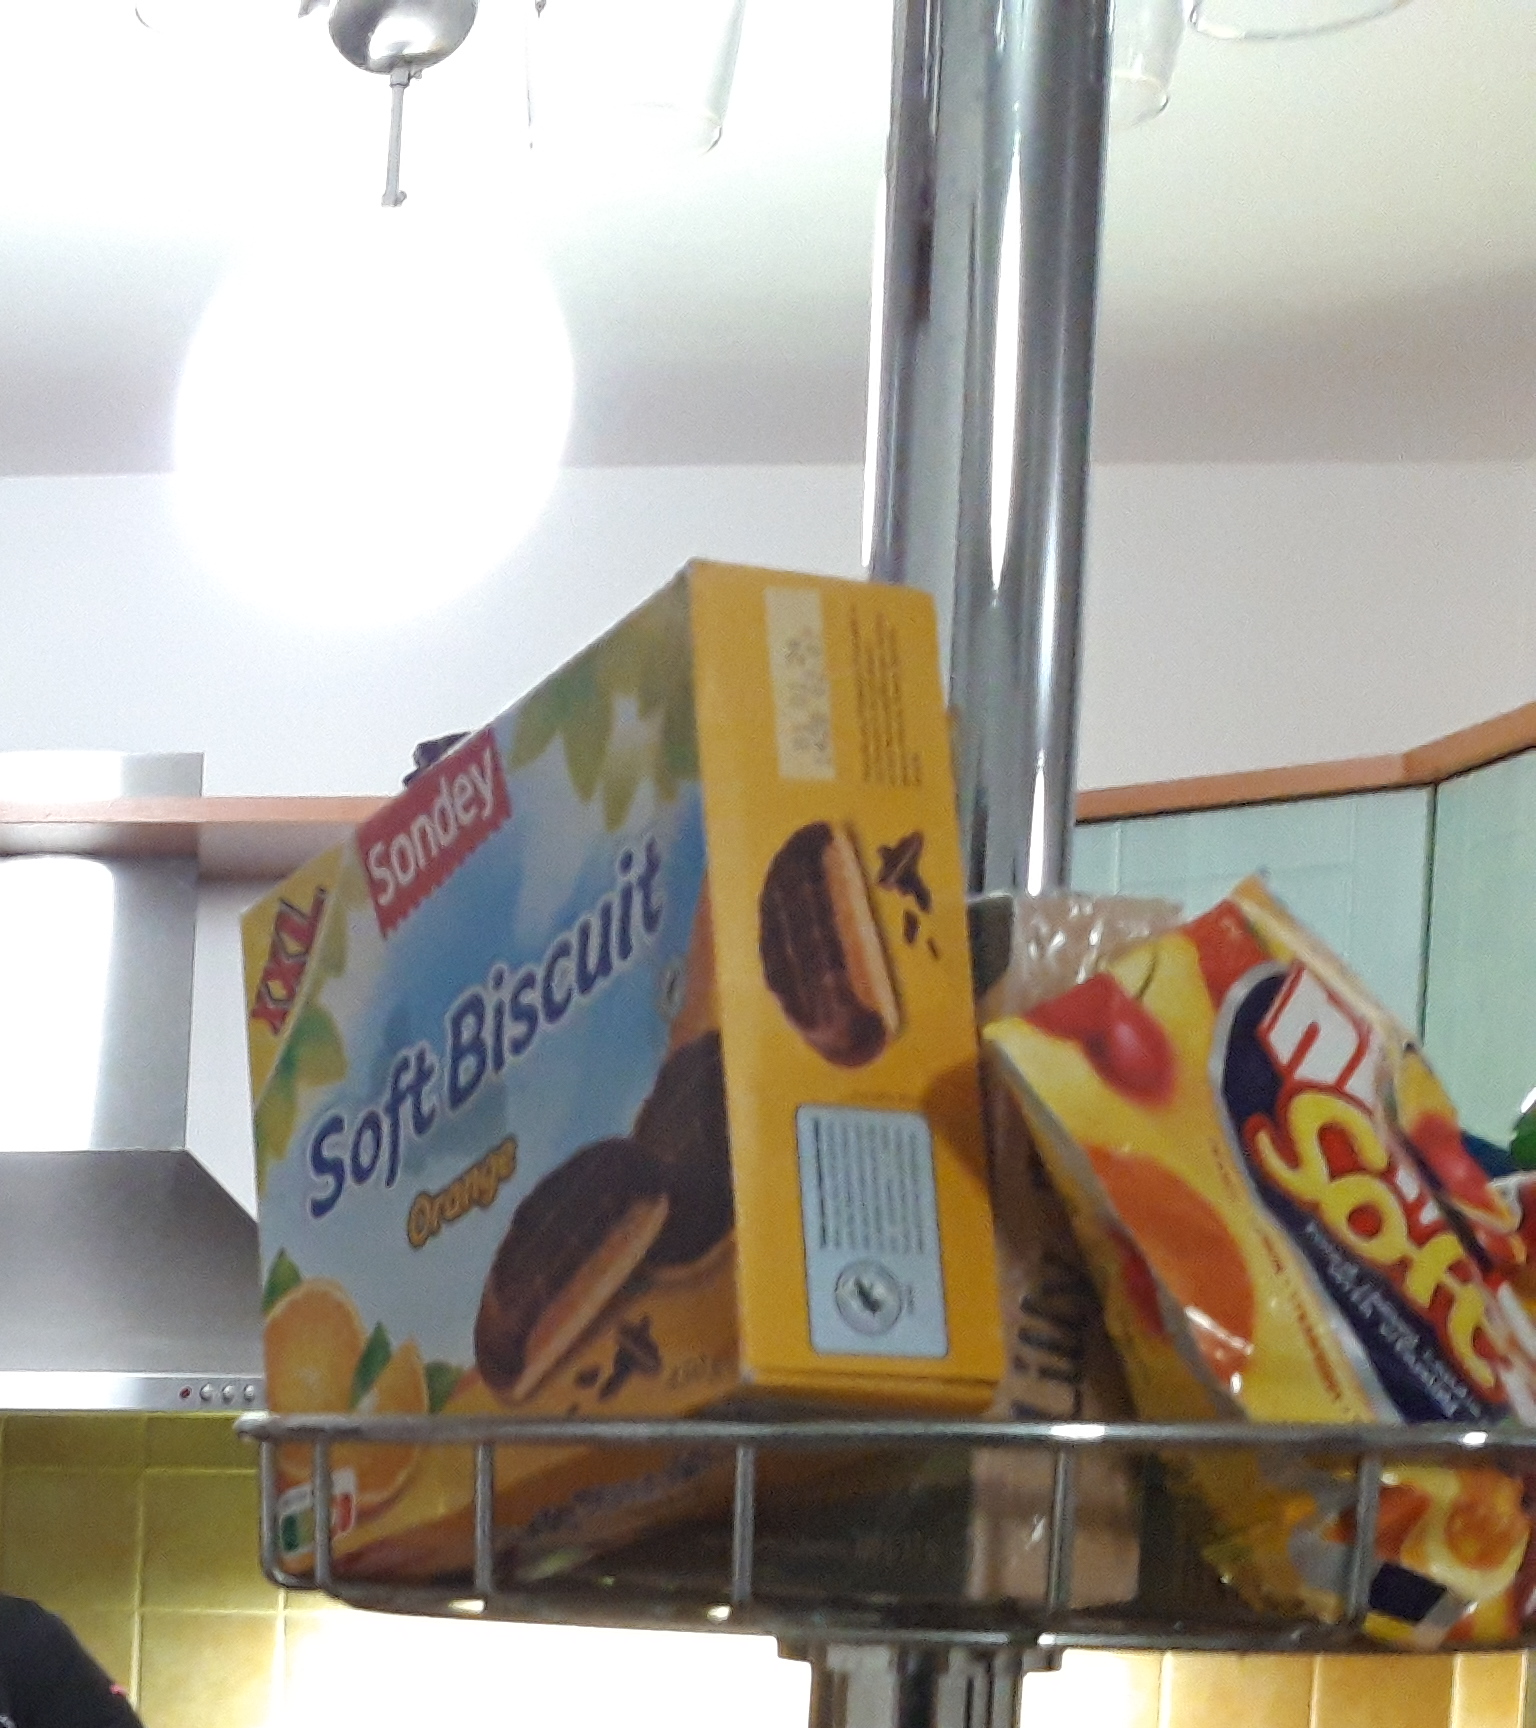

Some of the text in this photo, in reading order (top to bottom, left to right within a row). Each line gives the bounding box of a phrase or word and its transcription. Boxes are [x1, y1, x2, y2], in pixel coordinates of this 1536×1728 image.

[368, 764, 499, 906] Sondey
[251, 886, 326, 1035] XXL
[308, 834, 666, 1220] Soft Biscuit
[407, 1135, 518, 1250] Orange
[1253, 1089, 1495, 1388] Soft
